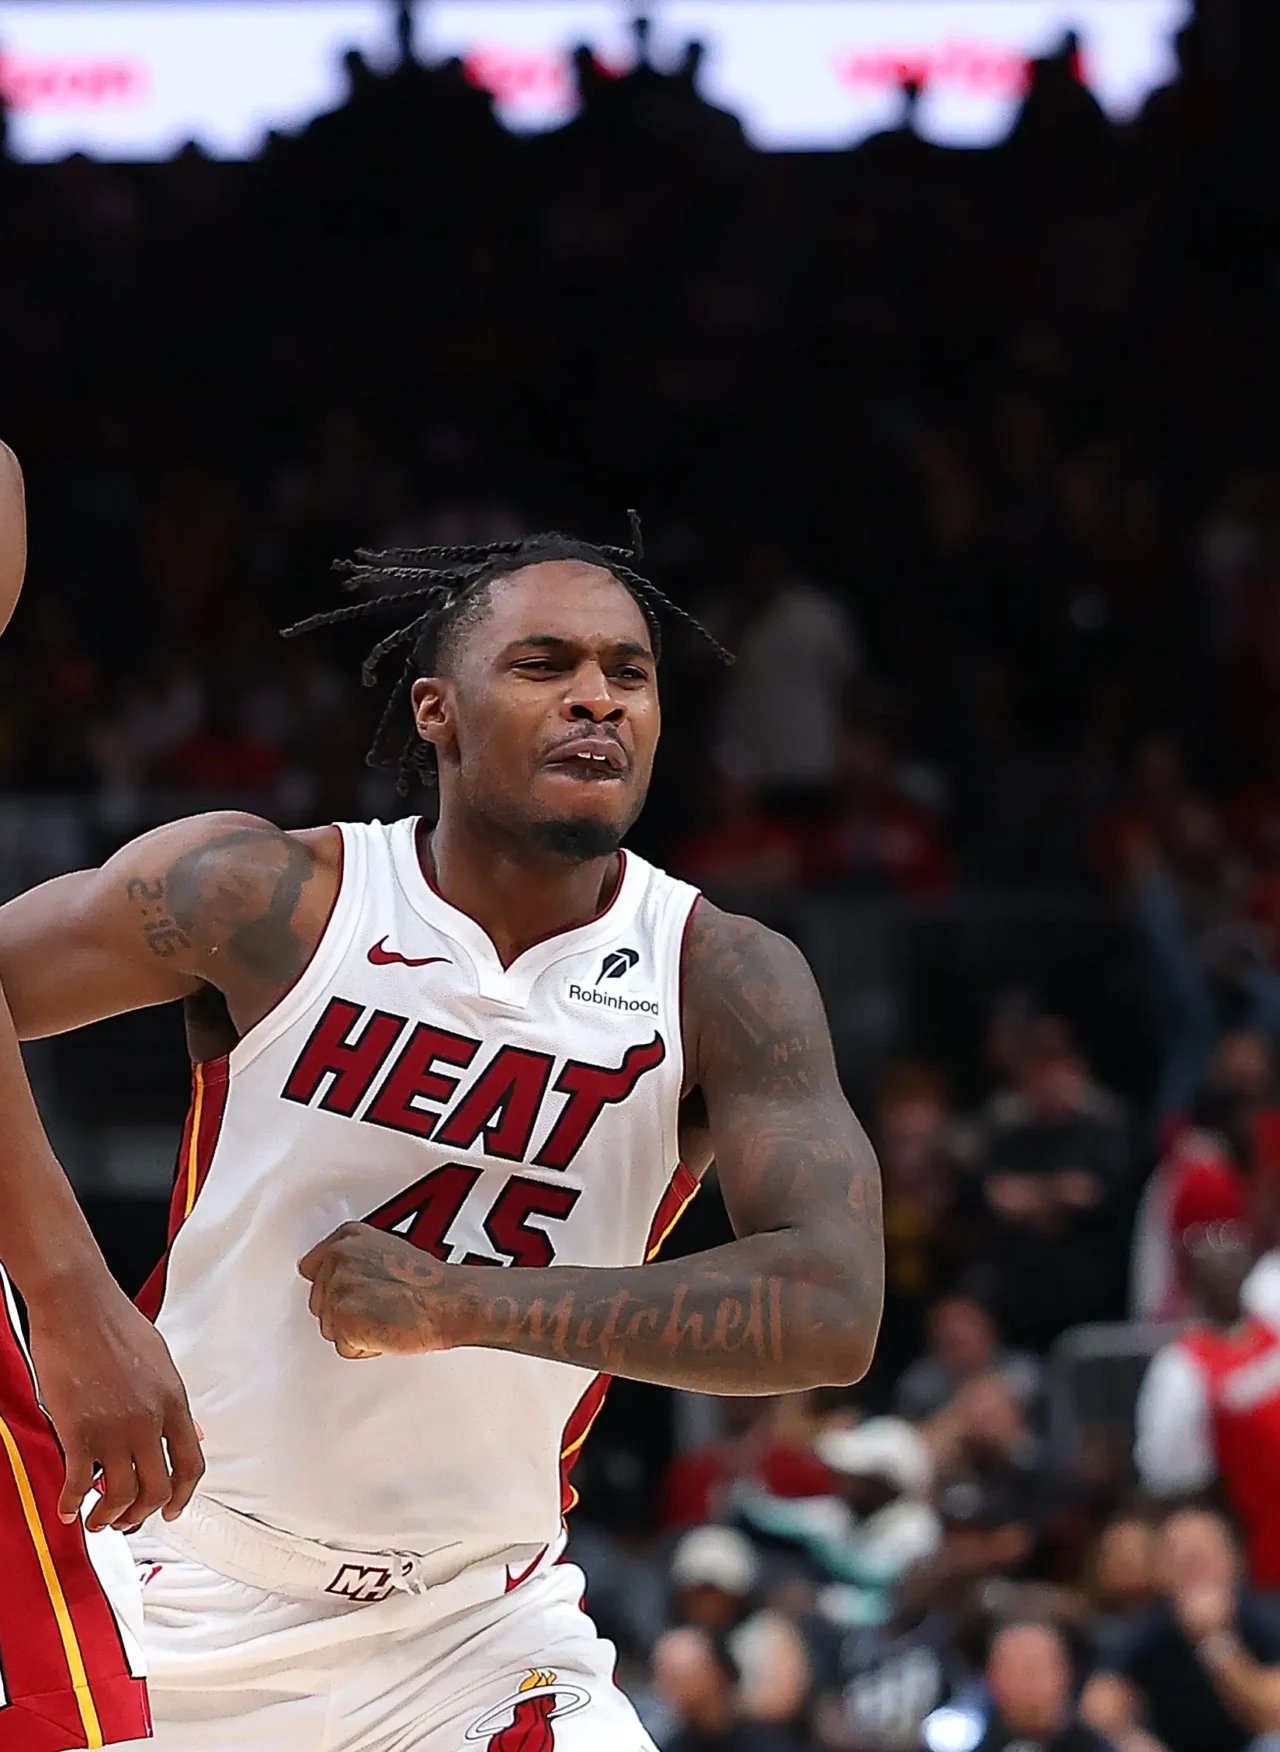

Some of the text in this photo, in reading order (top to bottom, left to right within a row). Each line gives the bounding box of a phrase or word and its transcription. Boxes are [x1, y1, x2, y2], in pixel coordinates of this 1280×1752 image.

[569, 984, 659, 1016] Robinhood
[280, 996, 666, 1172] HEAT
[358, 1162, 582, 1268] 45
